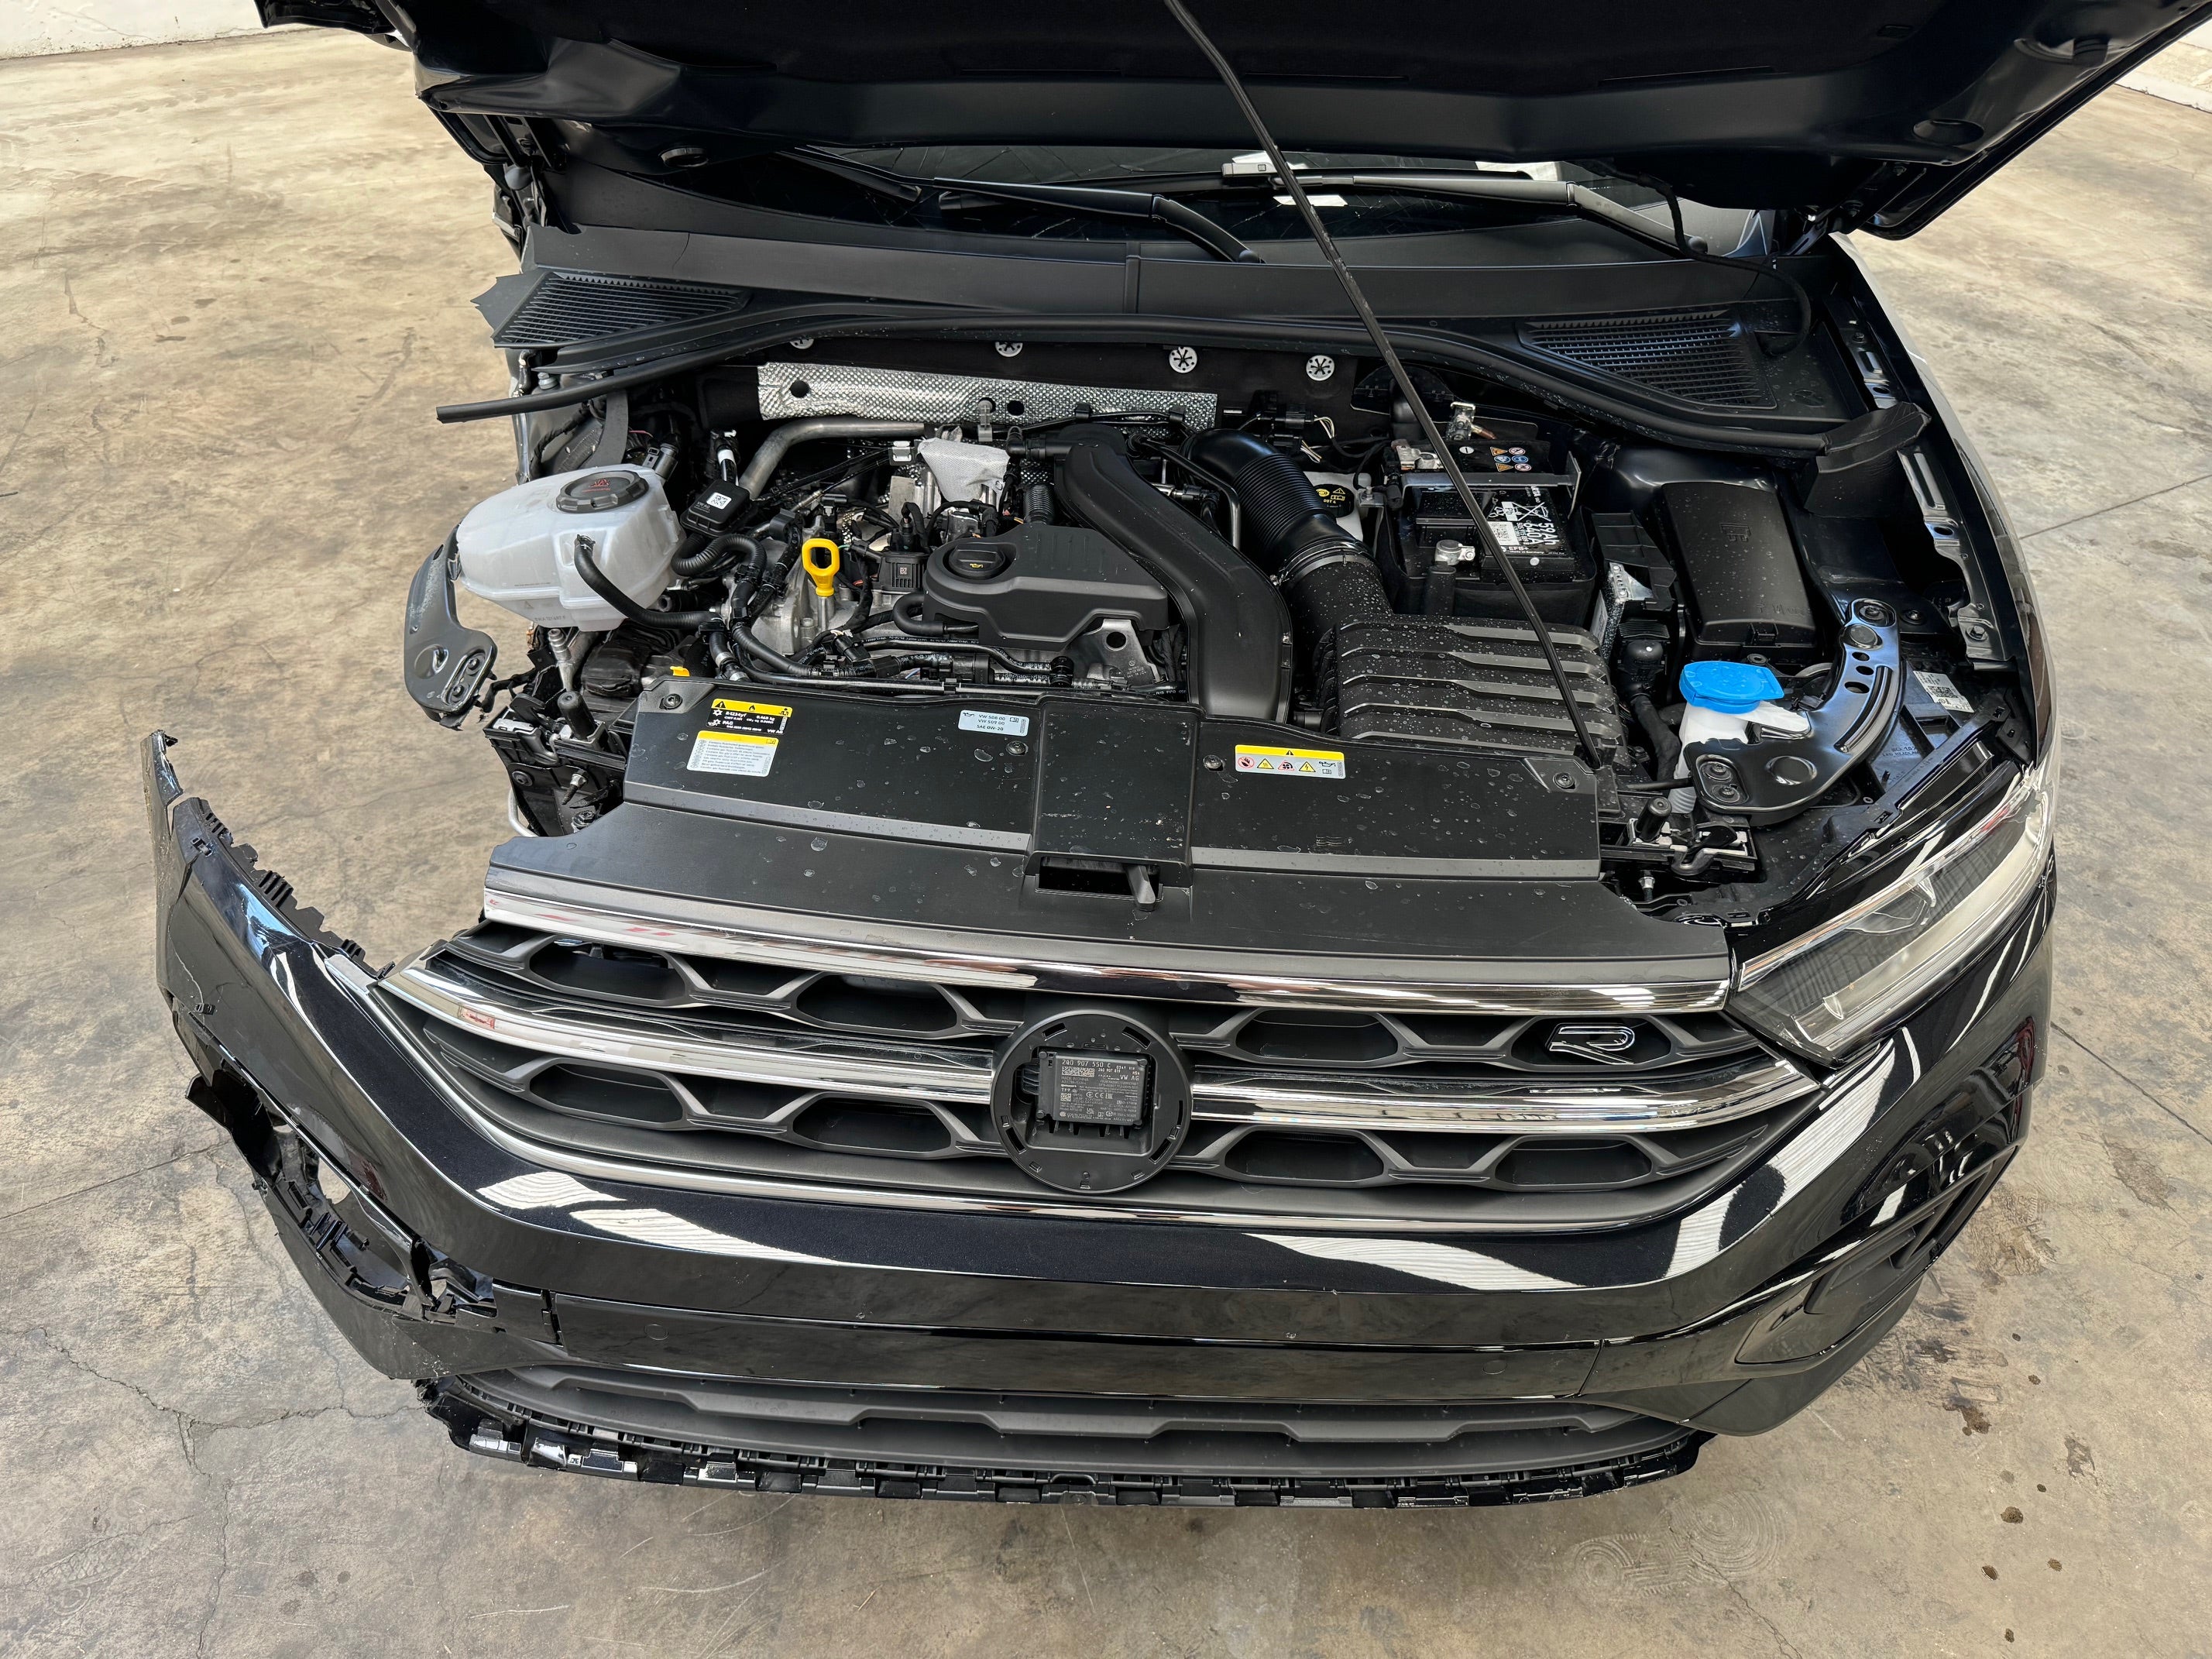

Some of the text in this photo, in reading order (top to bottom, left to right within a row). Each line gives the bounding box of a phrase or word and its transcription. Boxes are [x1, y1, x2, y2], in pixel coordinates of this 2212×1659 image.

[1523, 523, 1544, 544] 640A
[1538, 523, 1560, 545] 59Ah
[1546, 1023, 1636, 1065] R
